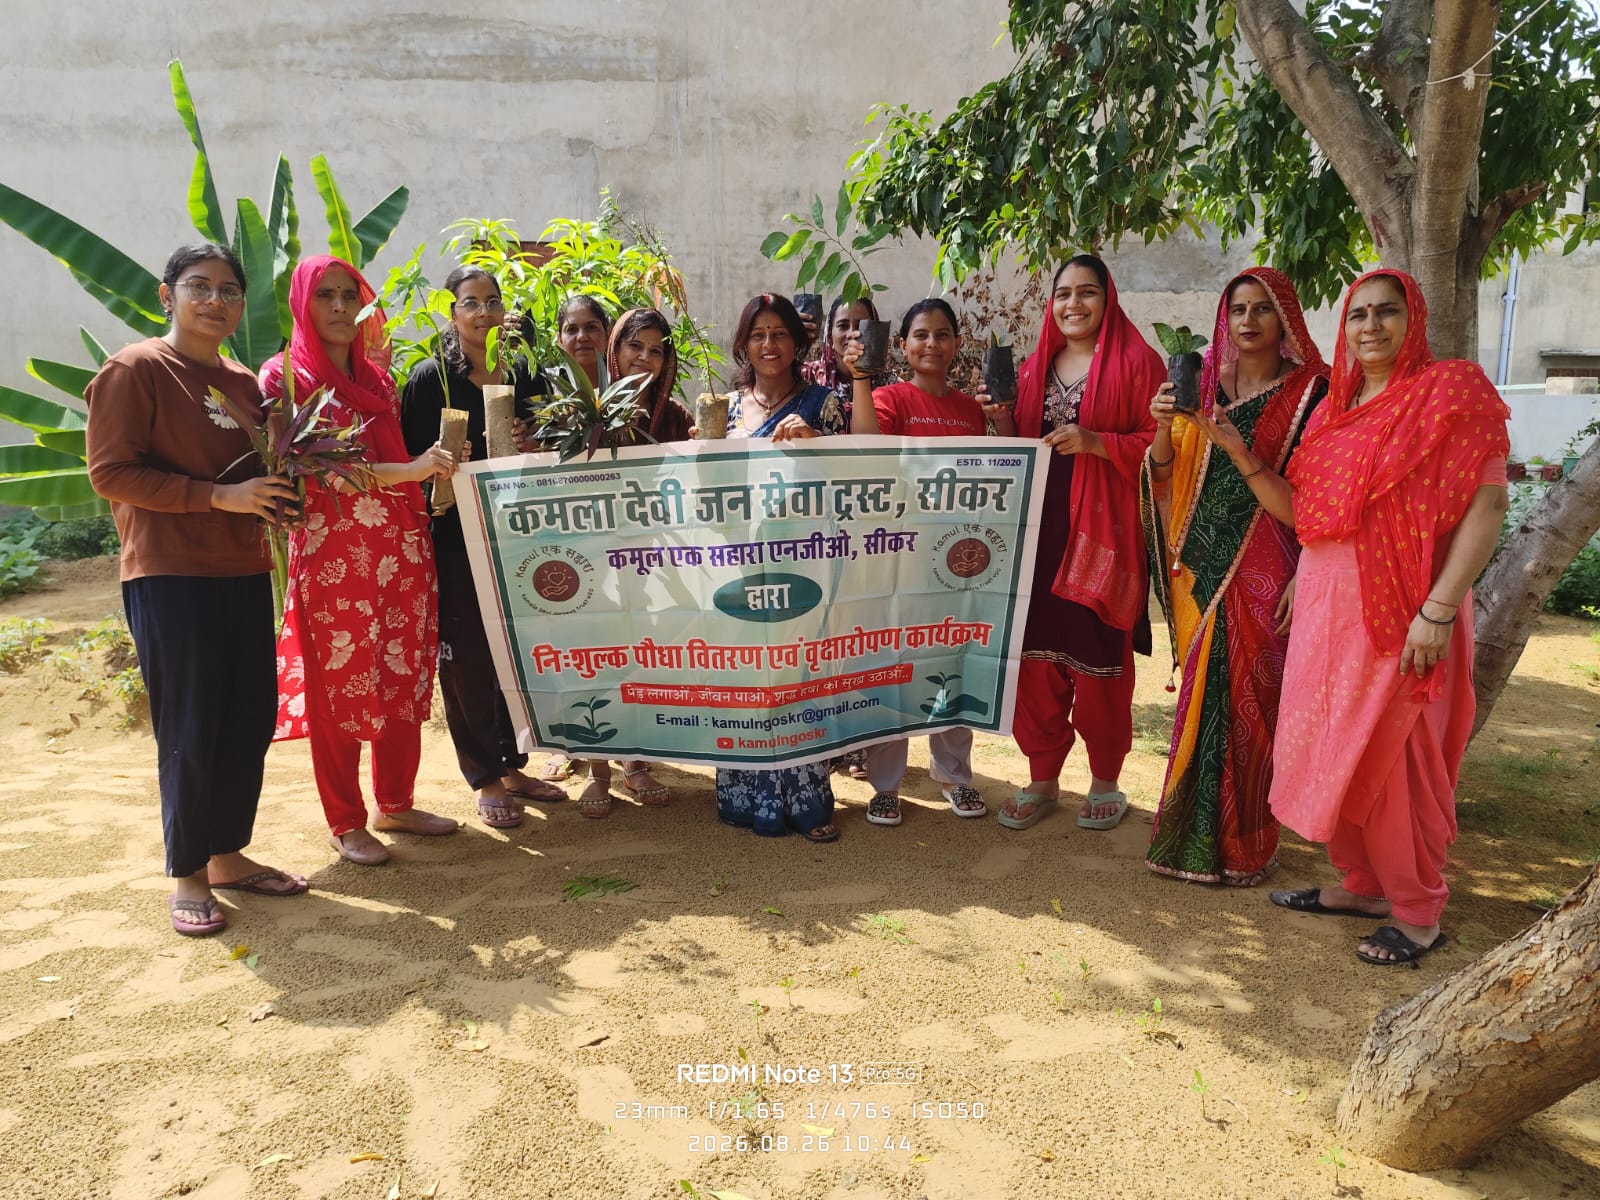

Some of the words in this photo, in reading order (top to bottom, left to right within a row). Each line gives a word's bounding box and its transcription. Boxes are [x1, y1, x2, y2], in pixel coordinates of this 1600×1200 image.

[956, 458, 984, 467] ESTD.
[987, 457, 1022, 467] 11/2020
[489, 483, 511, 492] SAN
[513, 480, 529, 490] No.
[503, 493, 616, 535] कमला
[620, 478, 687, 527] देवी
[691, 484, 754, 523] जन
[759, 472, 827, 519] सेवा
[831, 478, 907, 521] ट्रस्ट,
[917, 467, 1014, 512] सीकर
[605, 546, 664, 576] कमूल
[667, 546, 704, 567] एक
[707, 541, 765, 568] सहारा
[766, 529, 858, 564] एनजीओ,
[863, 527, 919, 553] सीकर
[932, 525, 960, 552] Kamul
[963, 523, 984, 535] एक
[514, 549, 540, 578] Kamul
[540, 545, 563, 557] एक
[565, 547, 595, 573] सहारा
[744, 583, 792, 610] द्वारा
[631, 638, 684, 669] पौधा
[686, 638, 764, 670] वितरण
[766, 637, 804, 668] एवं
[803, 626, 903, 671] वृक्षारोपण
[905, 617, 993, 647] कार्यक्रम
[823, 679, 840, 690] का
[656, 713, 699, 727] E-mail
[711, 696, 880, 732] kamulngoskr@gmail.com
[738, 728, 828, 750] kamulngoskr
